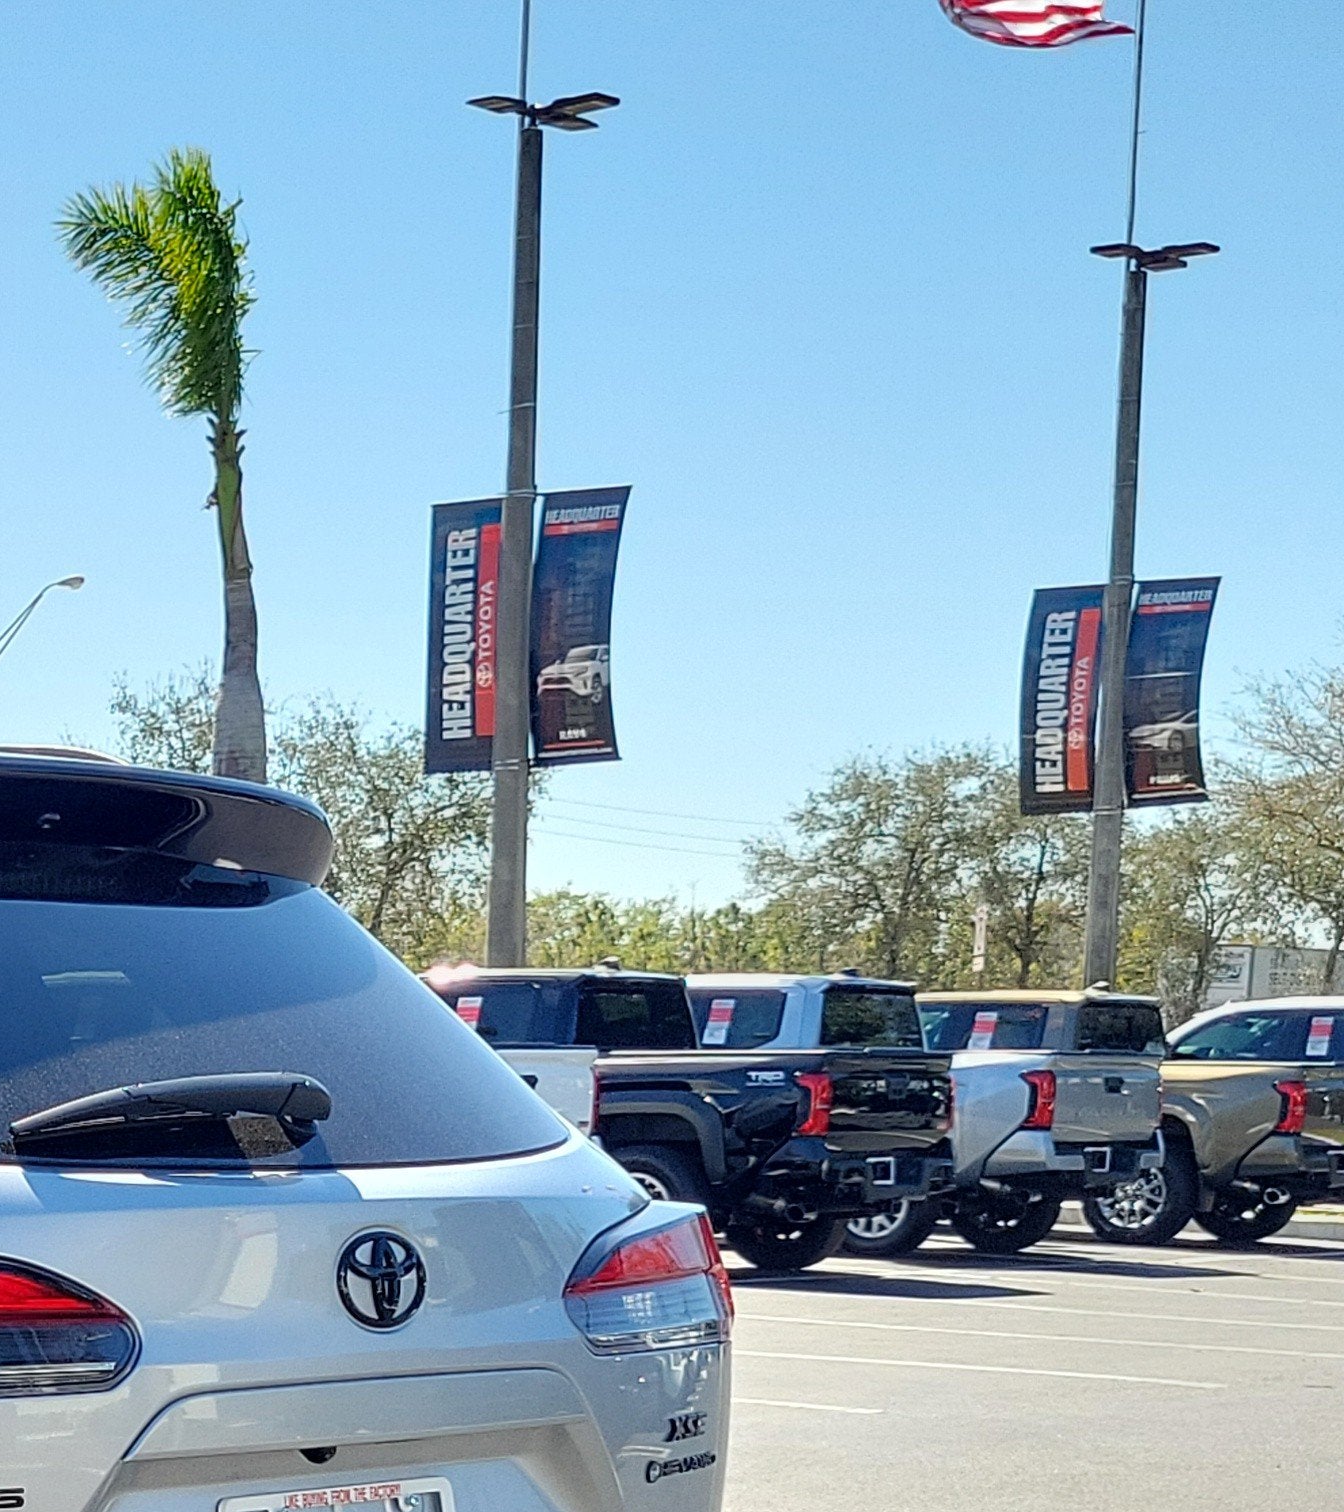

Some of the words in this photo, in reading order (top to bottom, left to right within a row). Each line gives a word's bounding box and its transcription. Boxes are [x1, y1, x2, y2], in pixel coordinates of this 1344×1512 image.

[442, 527, 478, 741] HEADQUARTER
[478, 581, 496, 660] TOYOTA
[1035, 609, 1077, 794] HEADQUARTER
[1070, 656, 1091, 726] TOYOTA
[745, 1070, 786, 1084] TRD
